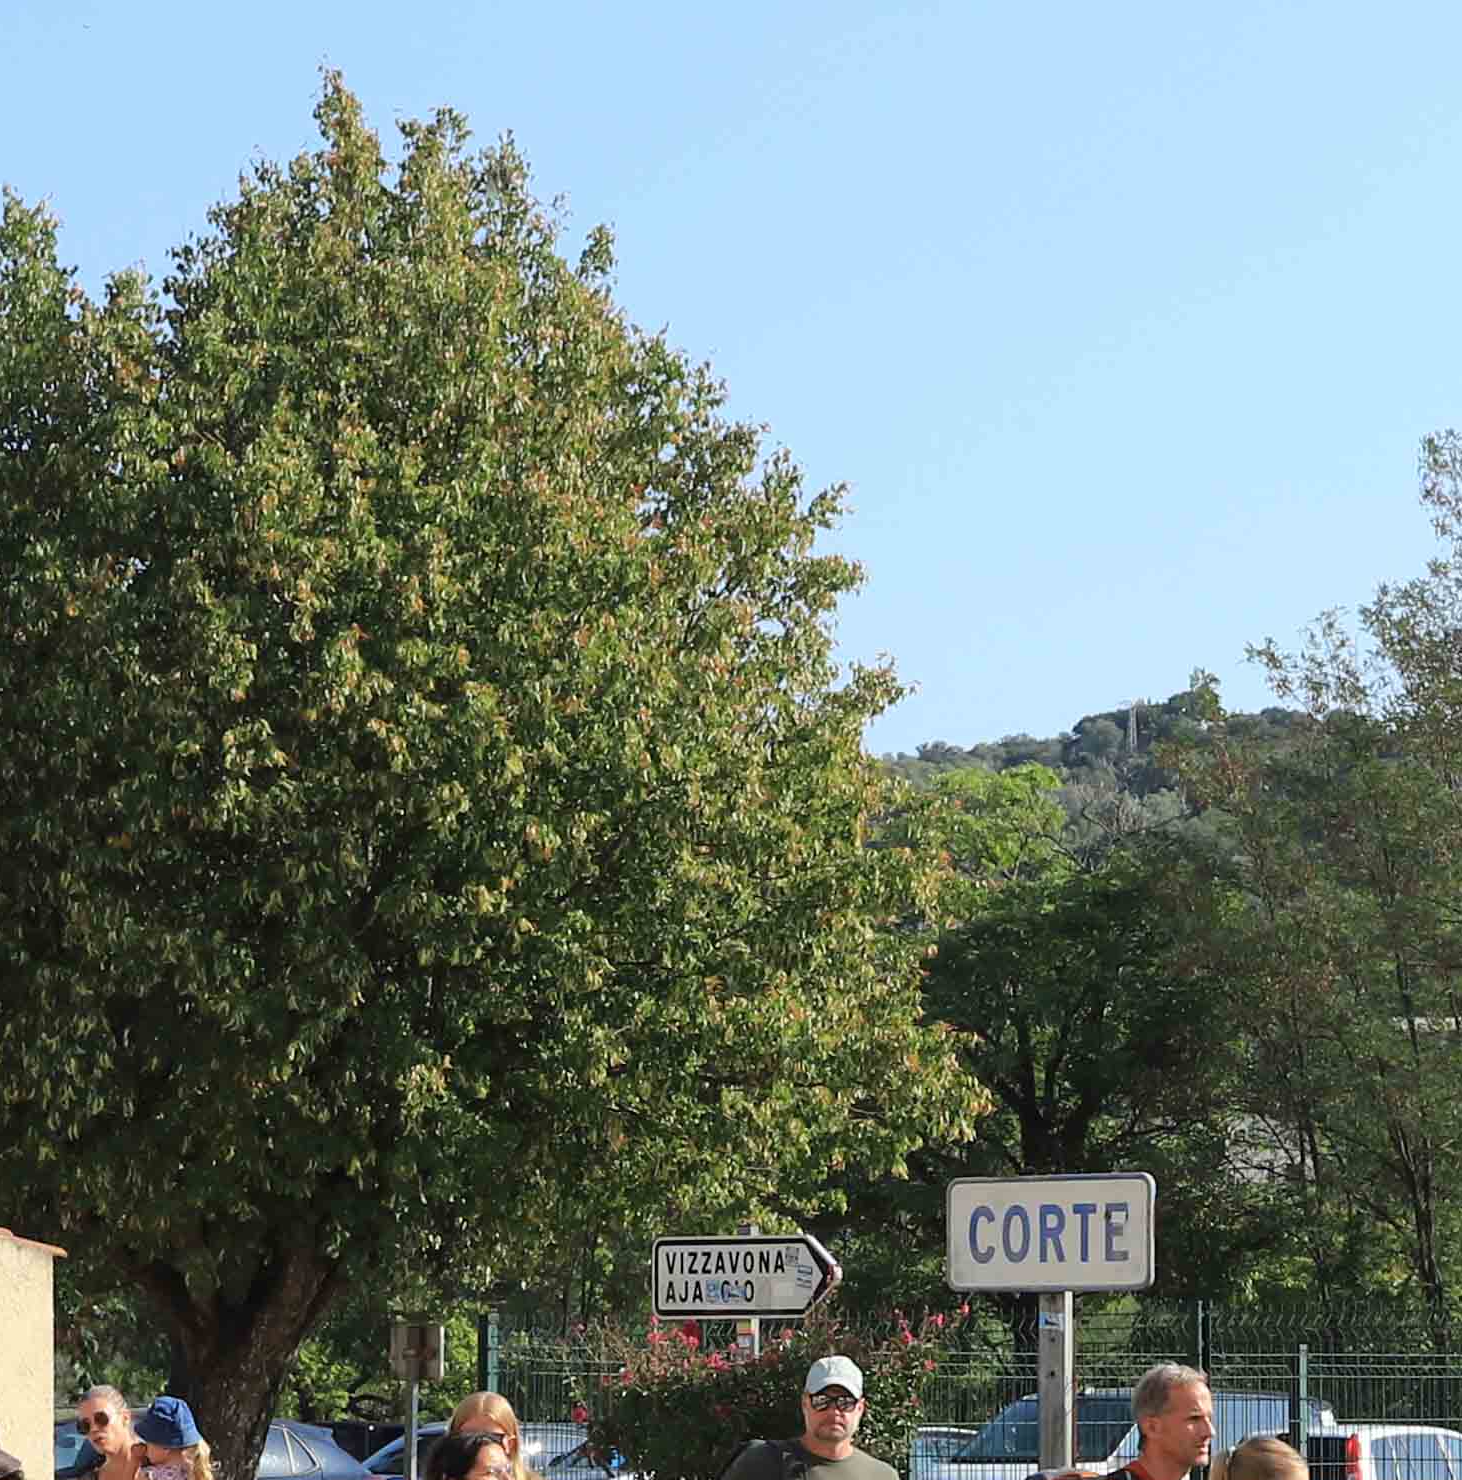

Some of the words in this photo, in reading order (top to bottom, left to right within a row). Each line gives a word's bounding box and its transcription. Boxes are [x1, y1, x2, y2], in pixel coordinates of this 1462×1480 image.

[969, 1202, 1129, 1264] CORTE
[665, 1250, 785, 1275] VIZZAVONA
[665, 1280, 755, 1303] AJACO
